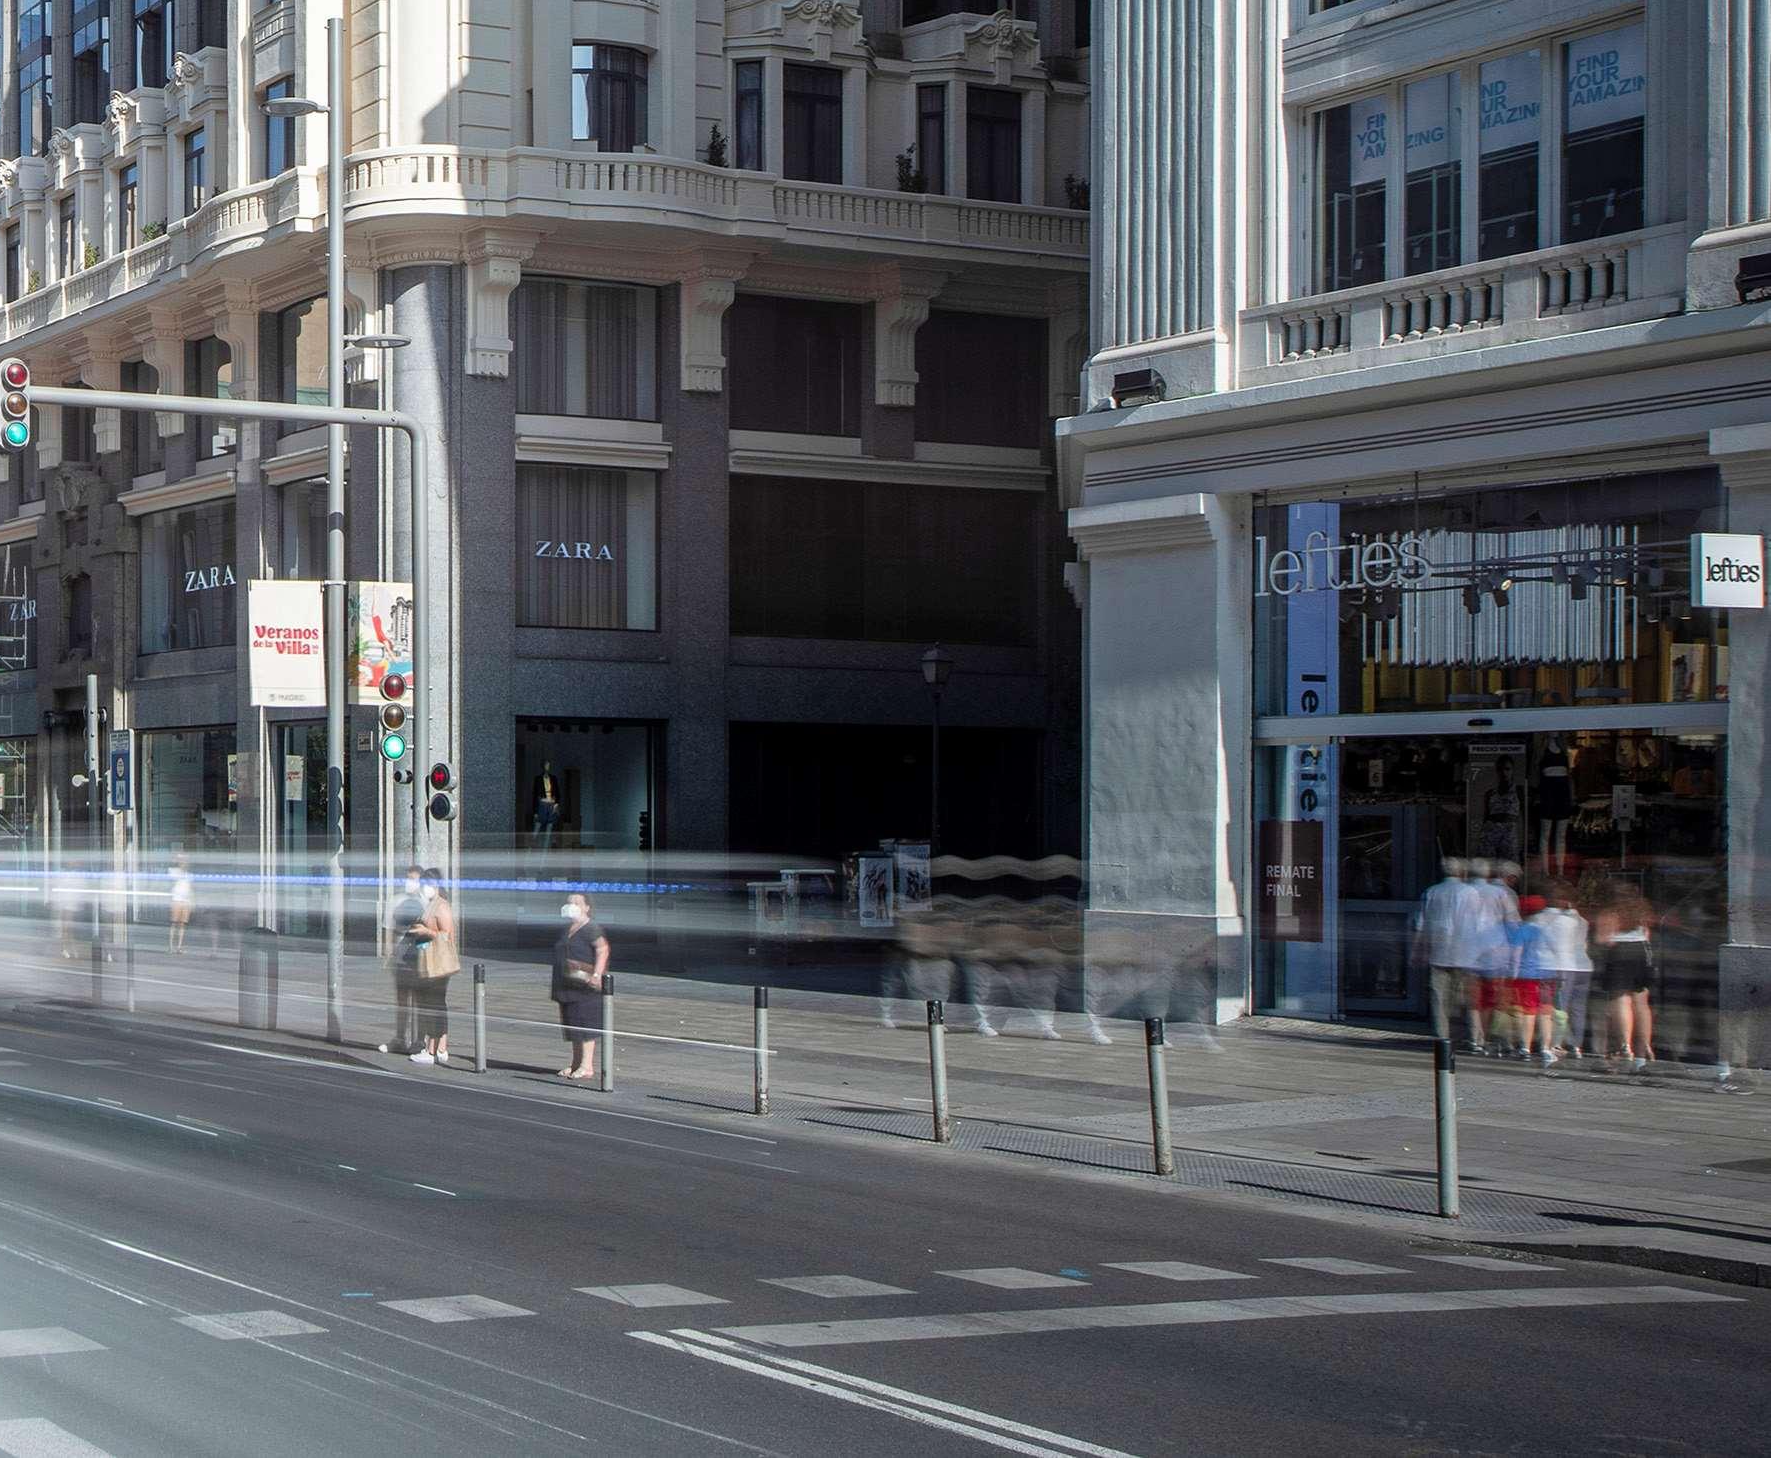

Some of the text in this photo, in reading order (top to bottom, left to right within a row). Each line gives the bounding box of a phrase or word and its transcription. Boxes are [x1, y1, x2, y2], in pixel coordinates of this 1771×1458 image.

[1576, 50, 1619, 74] FIND
[535, 540, 614, 561] ZARA
[1255, 531, 1431, 597] lefties
[1705, 556, 1760, 583] lefties
[185, 564, 237, 593] ZARA
[254, 625, 319, 640] Veranos
[253, 640, 263, 648] de
[275, 641, 311, 655] Villa
[1266, 865, 1315, 879] REMATE
[1266, 883, 1302, 898] FINAL
